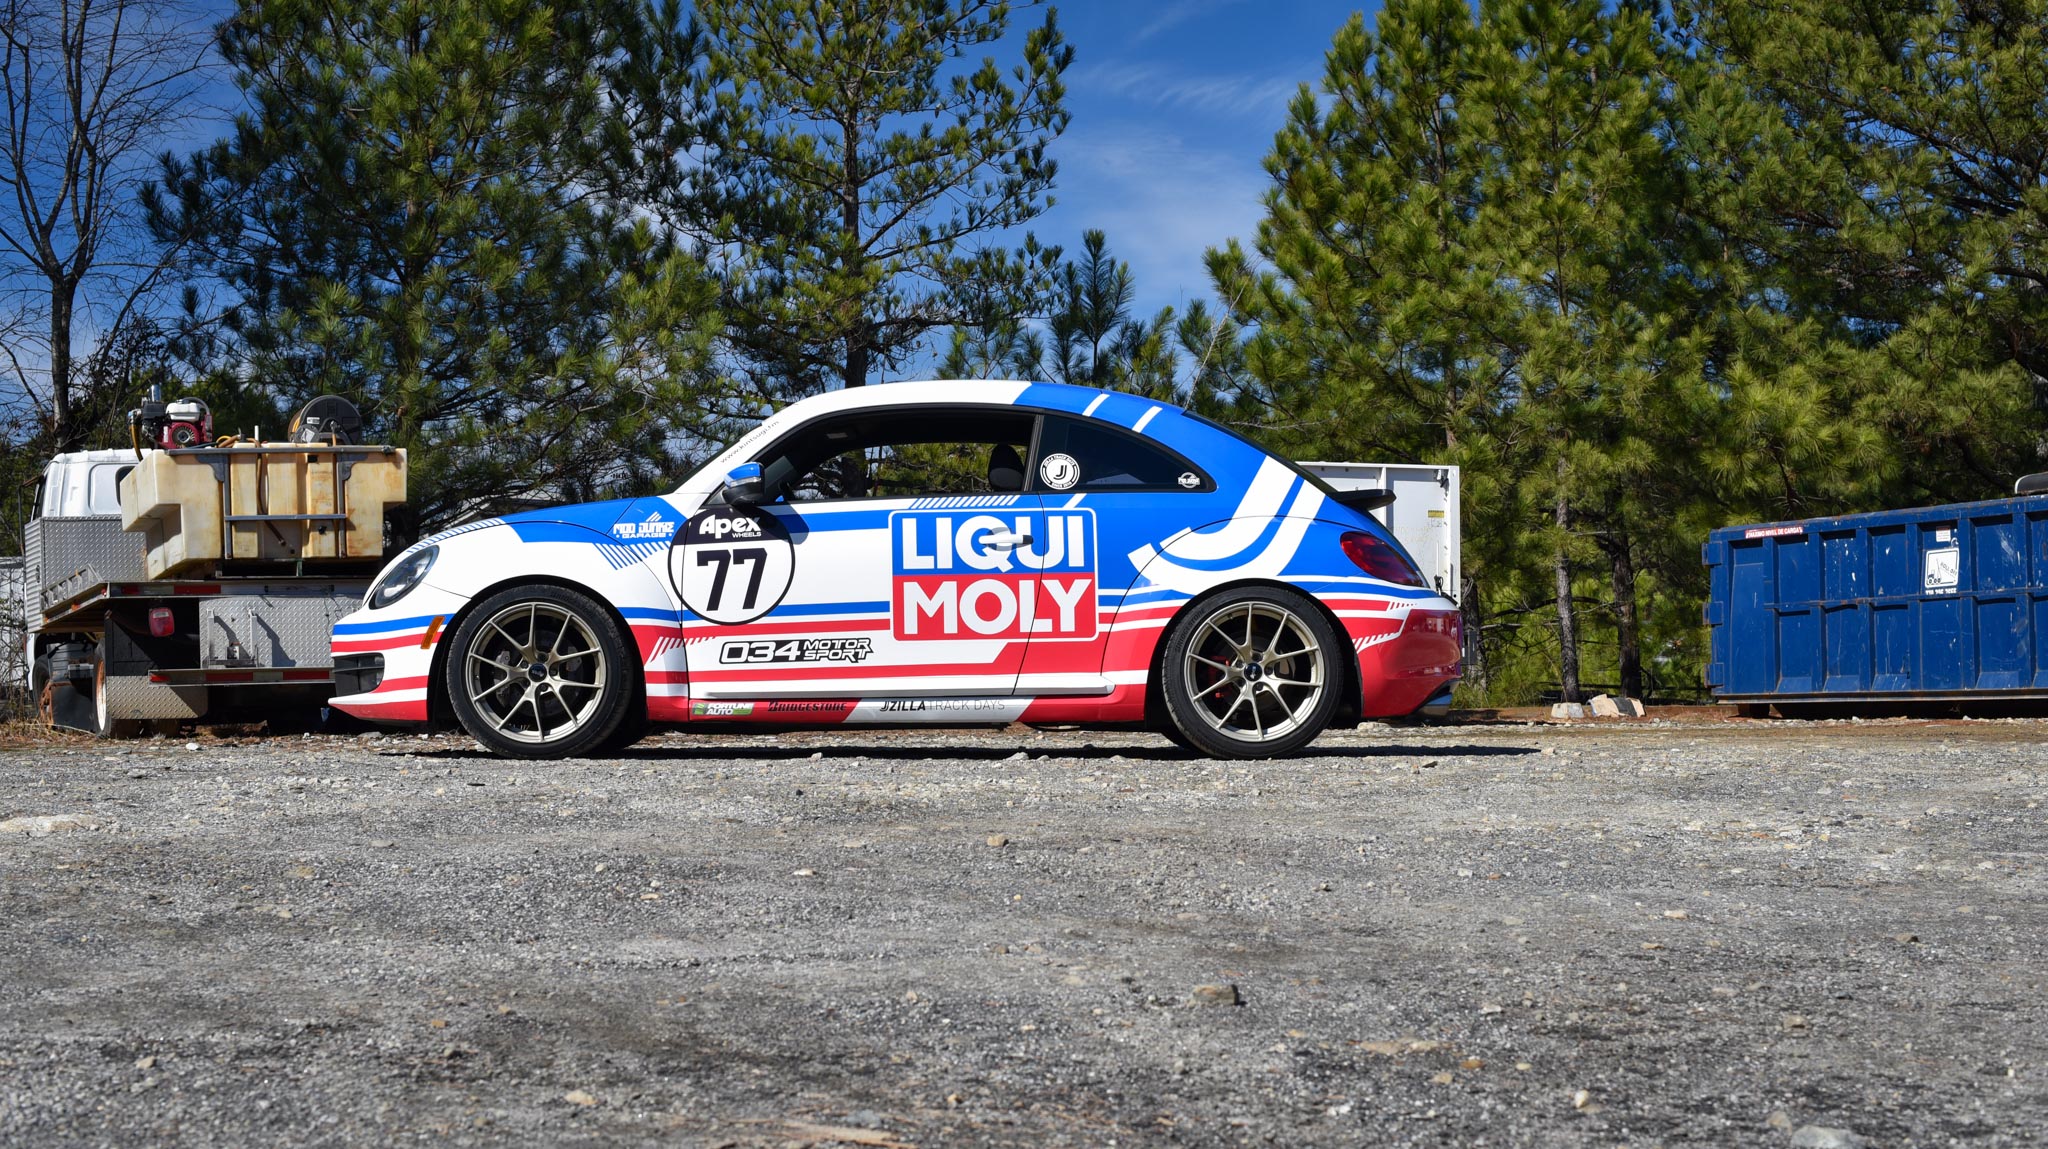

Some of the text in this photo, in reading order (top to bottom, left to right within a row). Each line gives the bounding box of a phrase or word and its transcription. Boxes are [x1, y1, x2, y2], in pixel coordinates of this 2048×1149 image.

[613, 522, 636, 534] MOD
[901, 515, 1085, 573] LIQUI
[696, 547, 768, 611] 77
[903, 578, 1092, 635] MOLY
[720, 638, 871, 663] 034 MOTOR
[803, 649, 869, 662] SPORT
[707, 702, 755, 710] FORTUNE
[768, 701, 847, 712] BRIDGESTONE
[928, 700, 970, 711] TRACK
[974, 699, 1005, 710] DAYS
